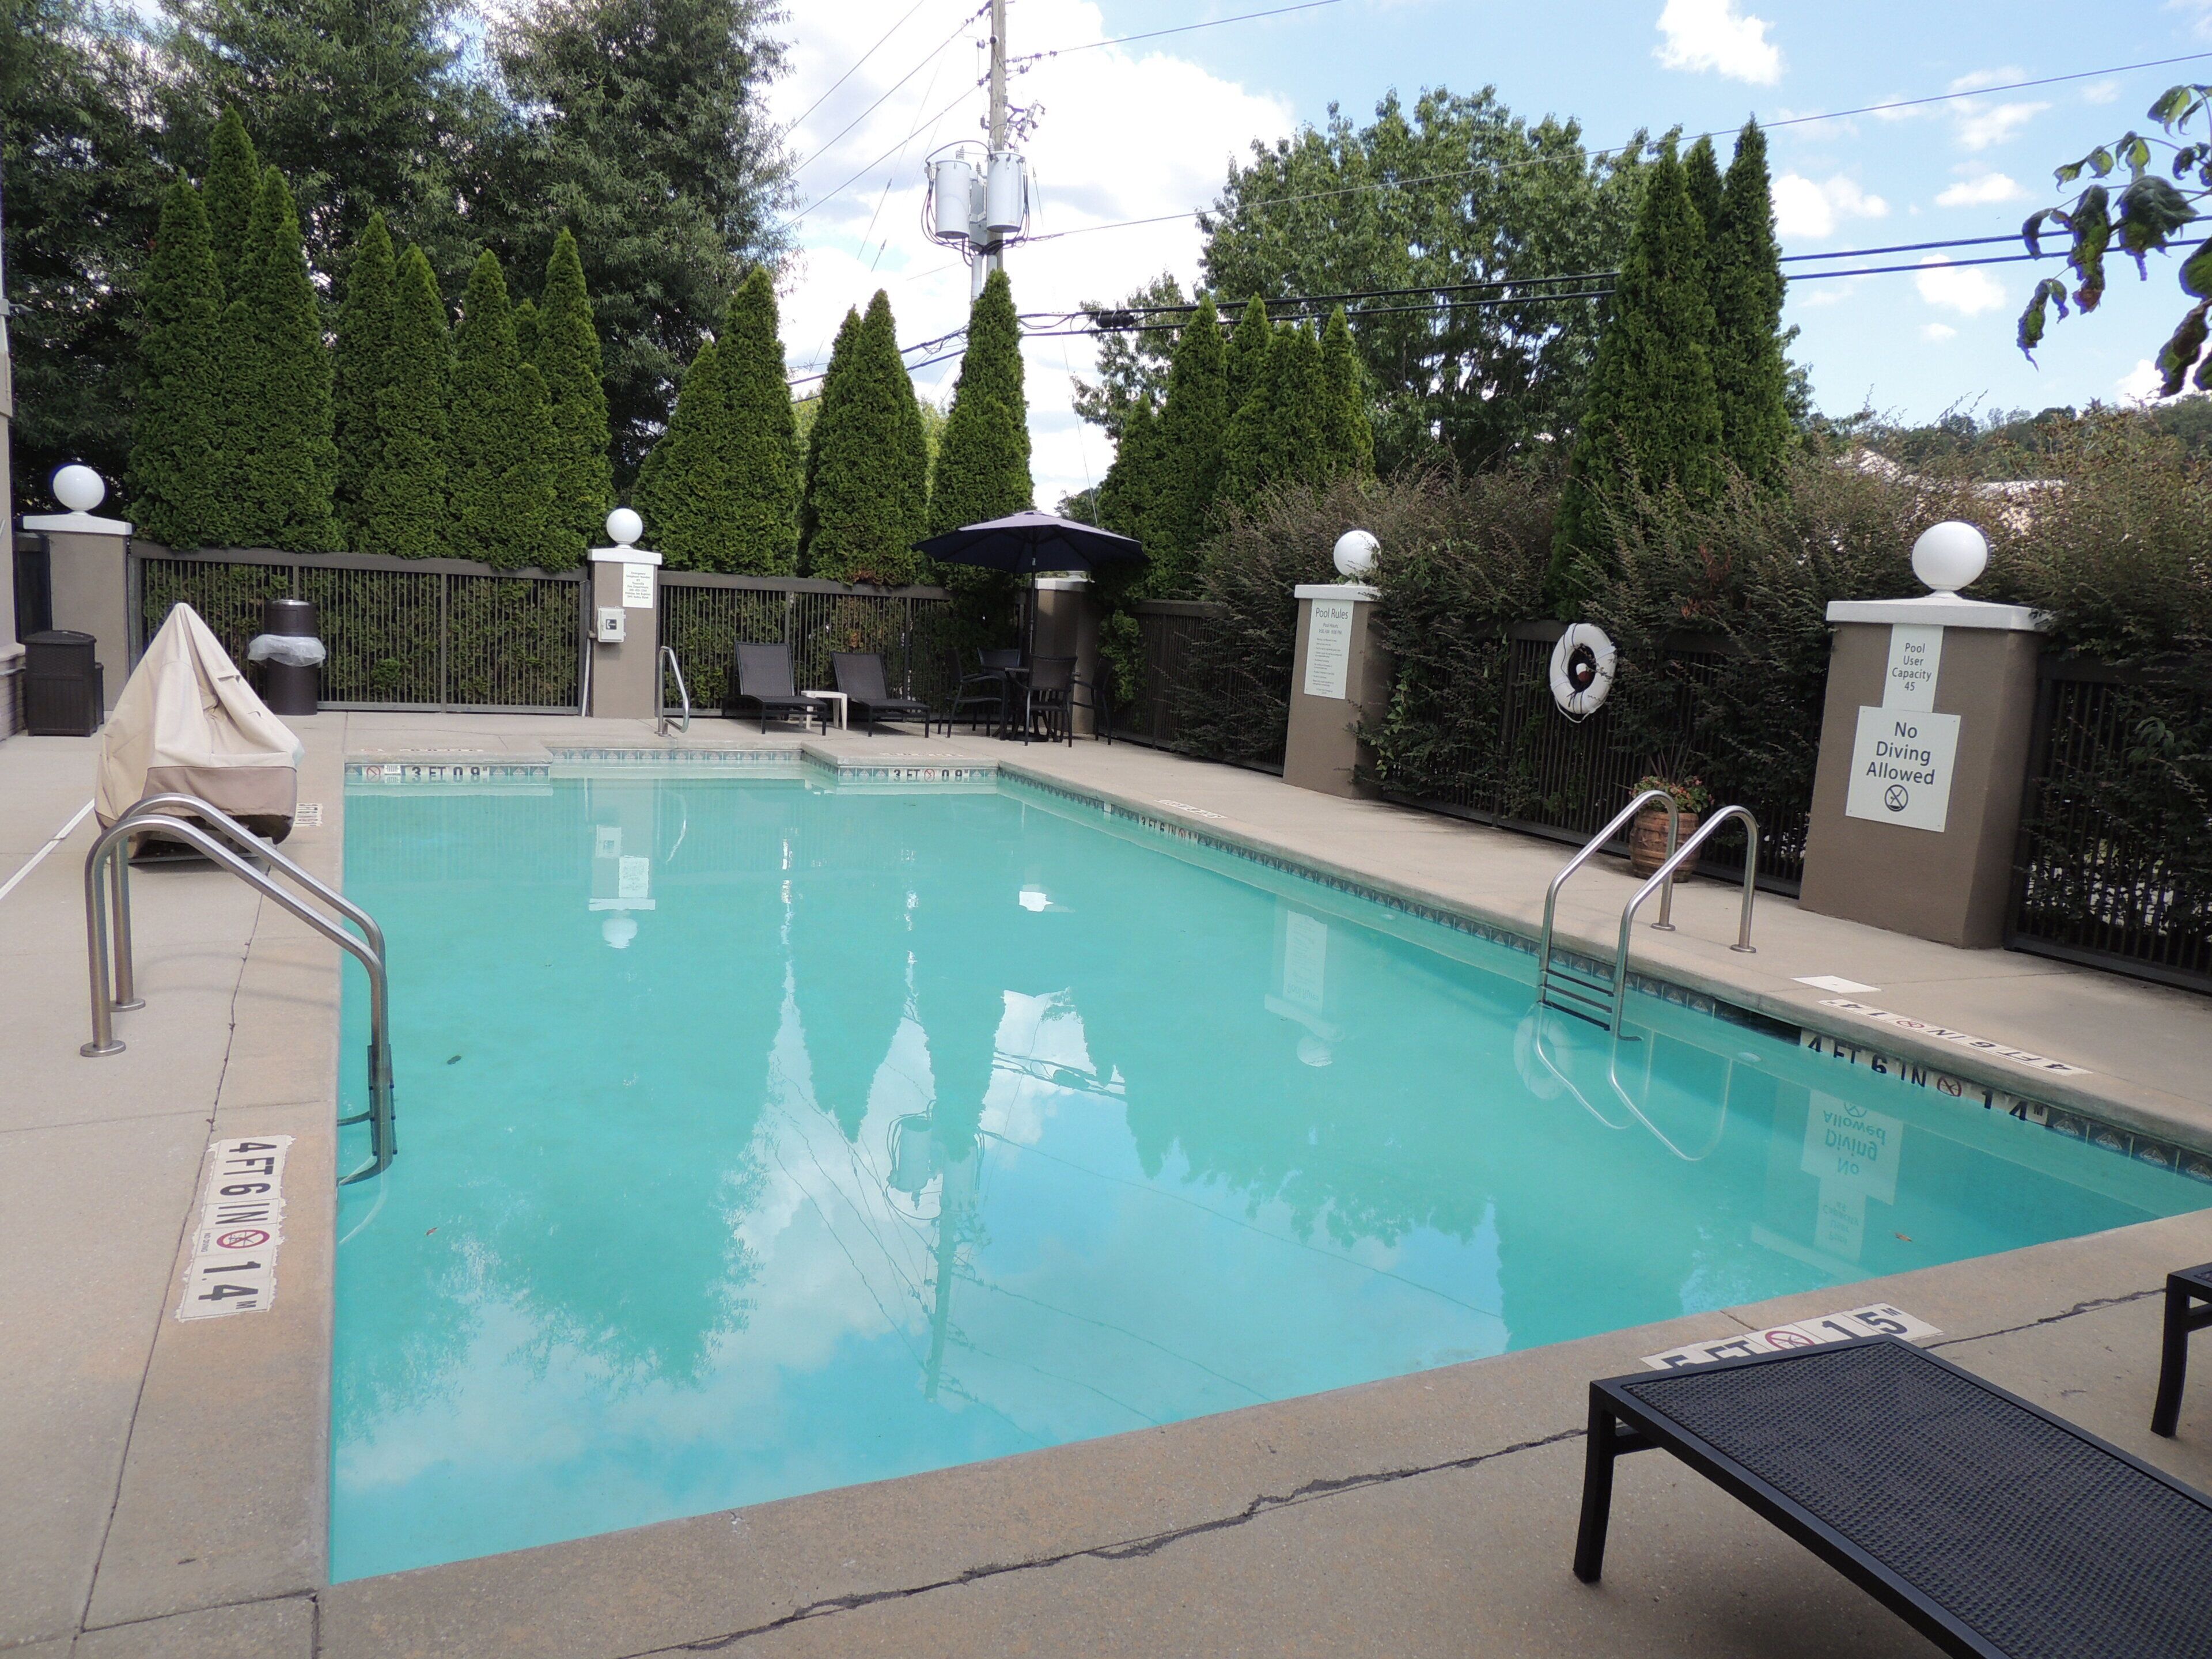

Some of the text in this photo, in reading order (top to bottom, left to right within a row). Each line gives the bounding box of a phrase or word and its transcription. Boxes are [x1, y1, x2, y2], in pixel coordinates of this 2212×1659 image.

[1316, 607, 1348, 619] Pool Rules
[1904, 642, 1926, 653] Pool
[1903, 655, 1924, 666] User
[1892, 667, 1932, 682] Capacity
[1904, 681, 1915, 691] 45
[1894, 721, 1918, 738] No
[1876, 741, 1931, 766] Diving
[1866, 761, 1936, 785] Allowed
[1927, 1029, 1967, 1039] IN
[1995, 1051, 2043, 1062] FT
[1871, 1053, 1888, 1074] 6
[1900, 1060, 1927, 1088] IN
[228, 1142, 277, 1153] 4
[223, 1156, 275, 1176] FT
[219, 1182, 271, 1196] 6
[215, 1202, 271, 1225] IN
